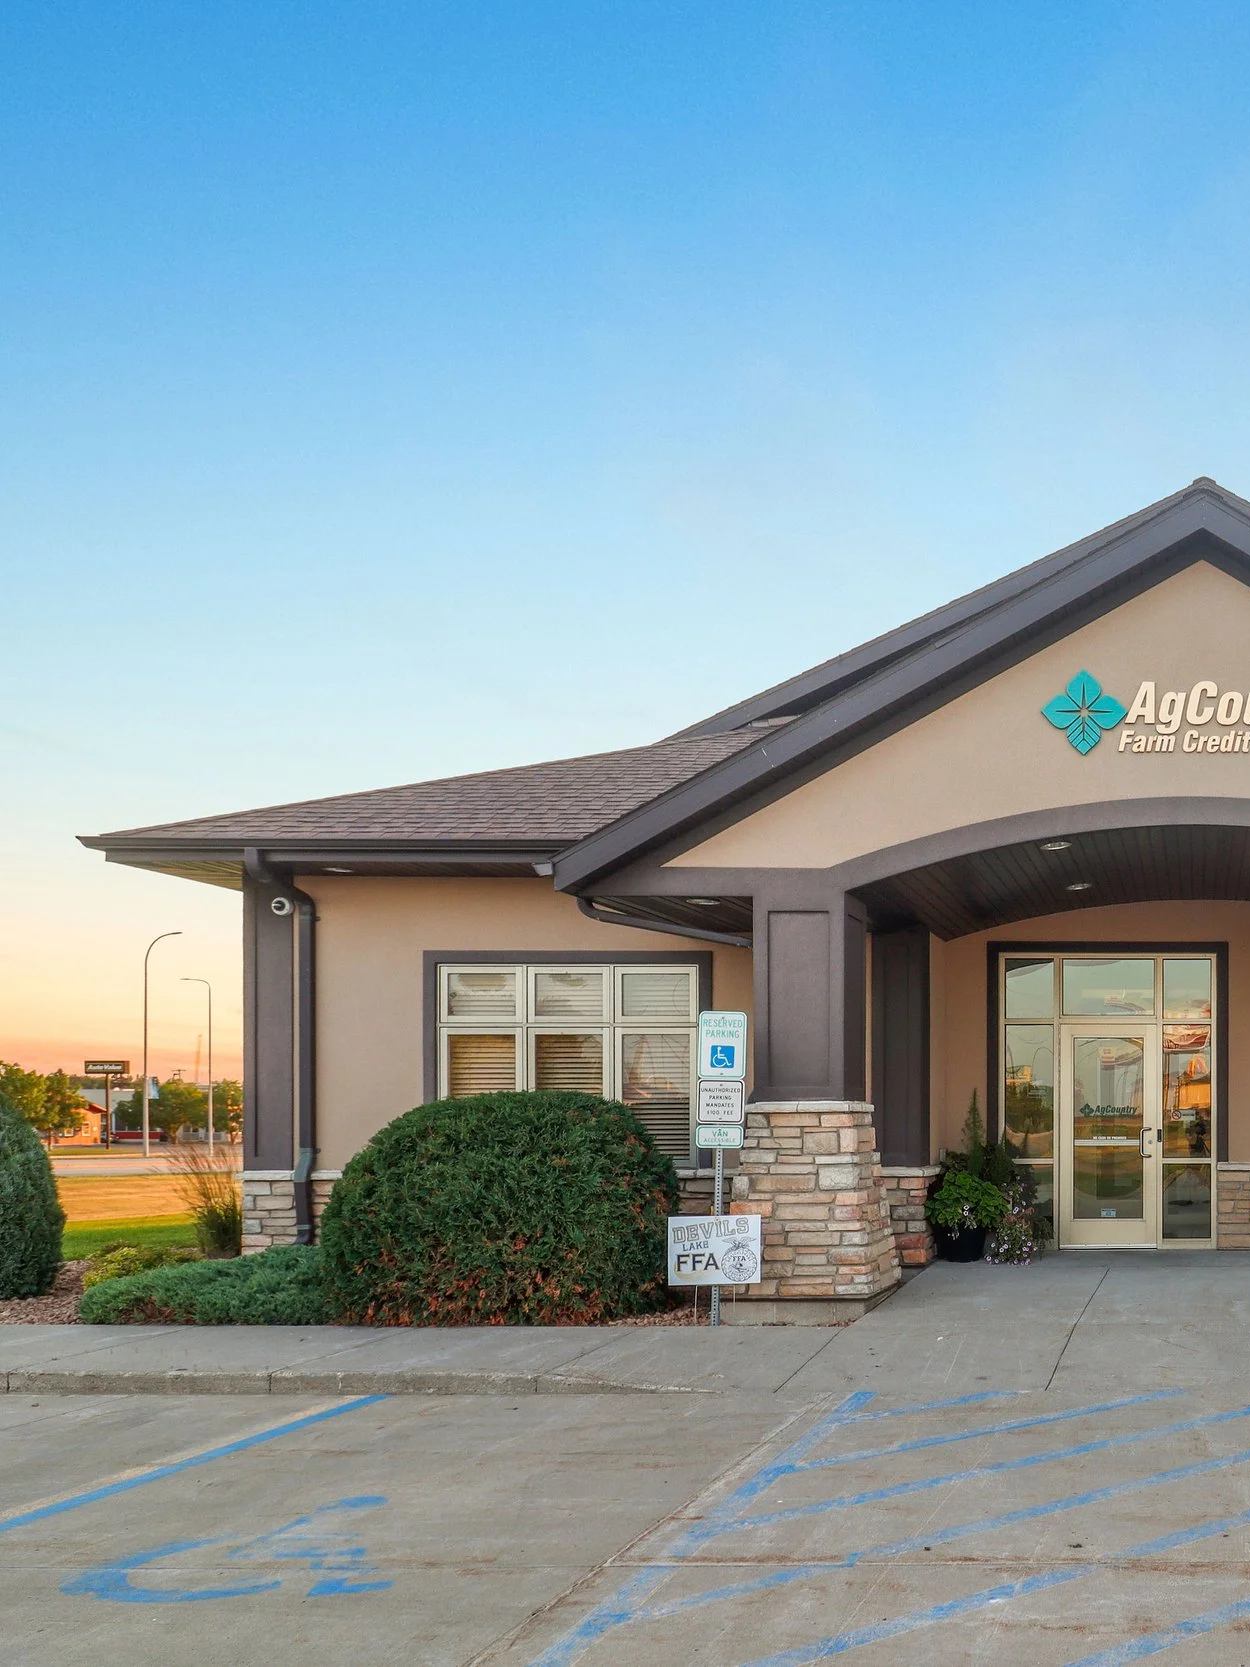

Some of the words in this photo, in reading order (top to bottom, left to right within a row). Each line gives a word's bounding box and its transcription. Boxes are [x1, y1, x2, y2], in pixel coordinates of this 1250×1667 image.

[1117, 730, 1176, 753] Farm
[703, 1019, 743, 1028] RESERVED
[705, 1030, 740, 1039] PARKING
[672, 1217, 750, 1244] DEVILS
[682, 1240, 710, 1252] LAKE
[676, 1253, 720, 1272] FFA
